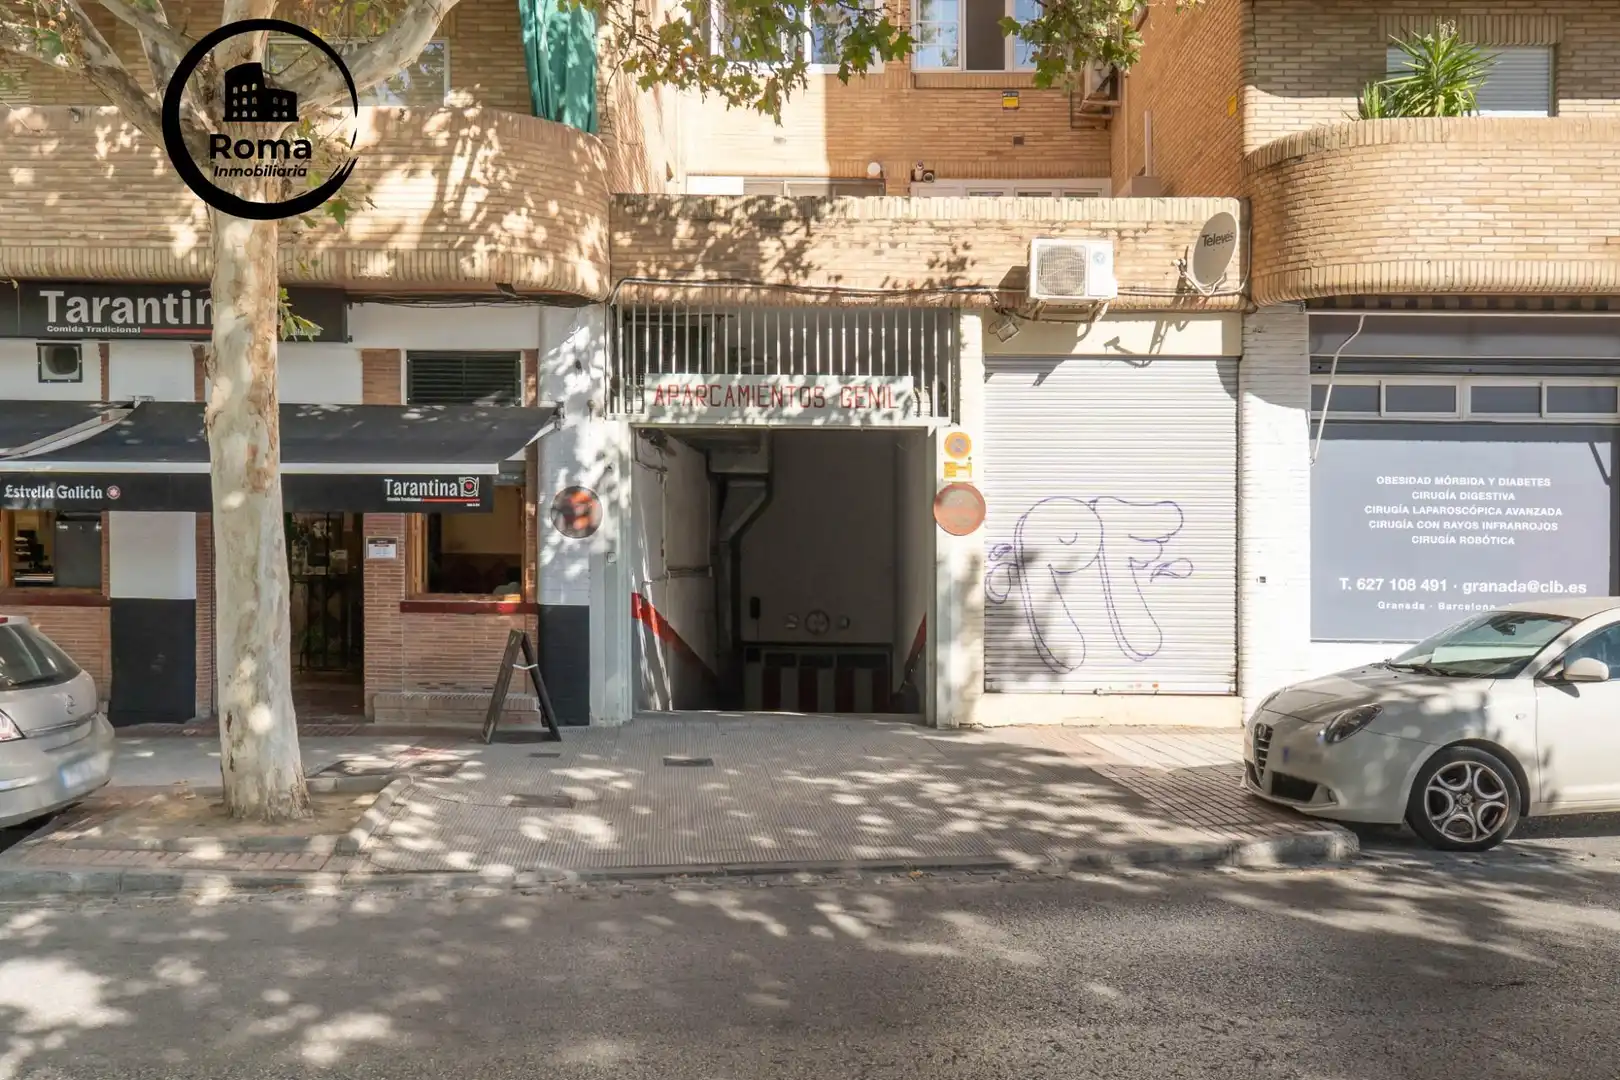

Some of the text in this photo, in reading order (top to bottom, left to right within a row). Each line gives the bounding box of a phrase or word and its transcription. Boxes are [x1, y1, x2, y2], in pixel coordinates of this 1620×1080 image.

[1202, 231, 1234, 247] Televés
[39, 289, 213, 325] Tarantin
[46, 325, 141, 334] Comida Tradicional
[653, 384, 899, 409] APARCAMIENTOS GENIL
[384, 478, 458, 496] Tarantina
[1376, 474, 1551, 487] OBESIDAD MÓRBIDA Y DIABETES
[3, 484, 103, 499] Estrella Galicia
[1411, 488, 1515, 501] CIRUGÍA DIGESTIVA
[1364, 502, 1563, 516] CIRUGÍA LAPAROSCÓPICA AVANZADA
[1368, 518, 1559, 531] CIRUGÍA CON RAYOS INFRARROJOS
[1411, 533, 1515, 545] CIRUGÍA ROBÓTICA
[1339, 577, 1352, 590] T.
[1356, 578, 1384, 591] 627
[1389, 579, 1417, 592] 108
[1420, 579, 1447, 592] 491
[1377, 601, 1425, 610] Granada
